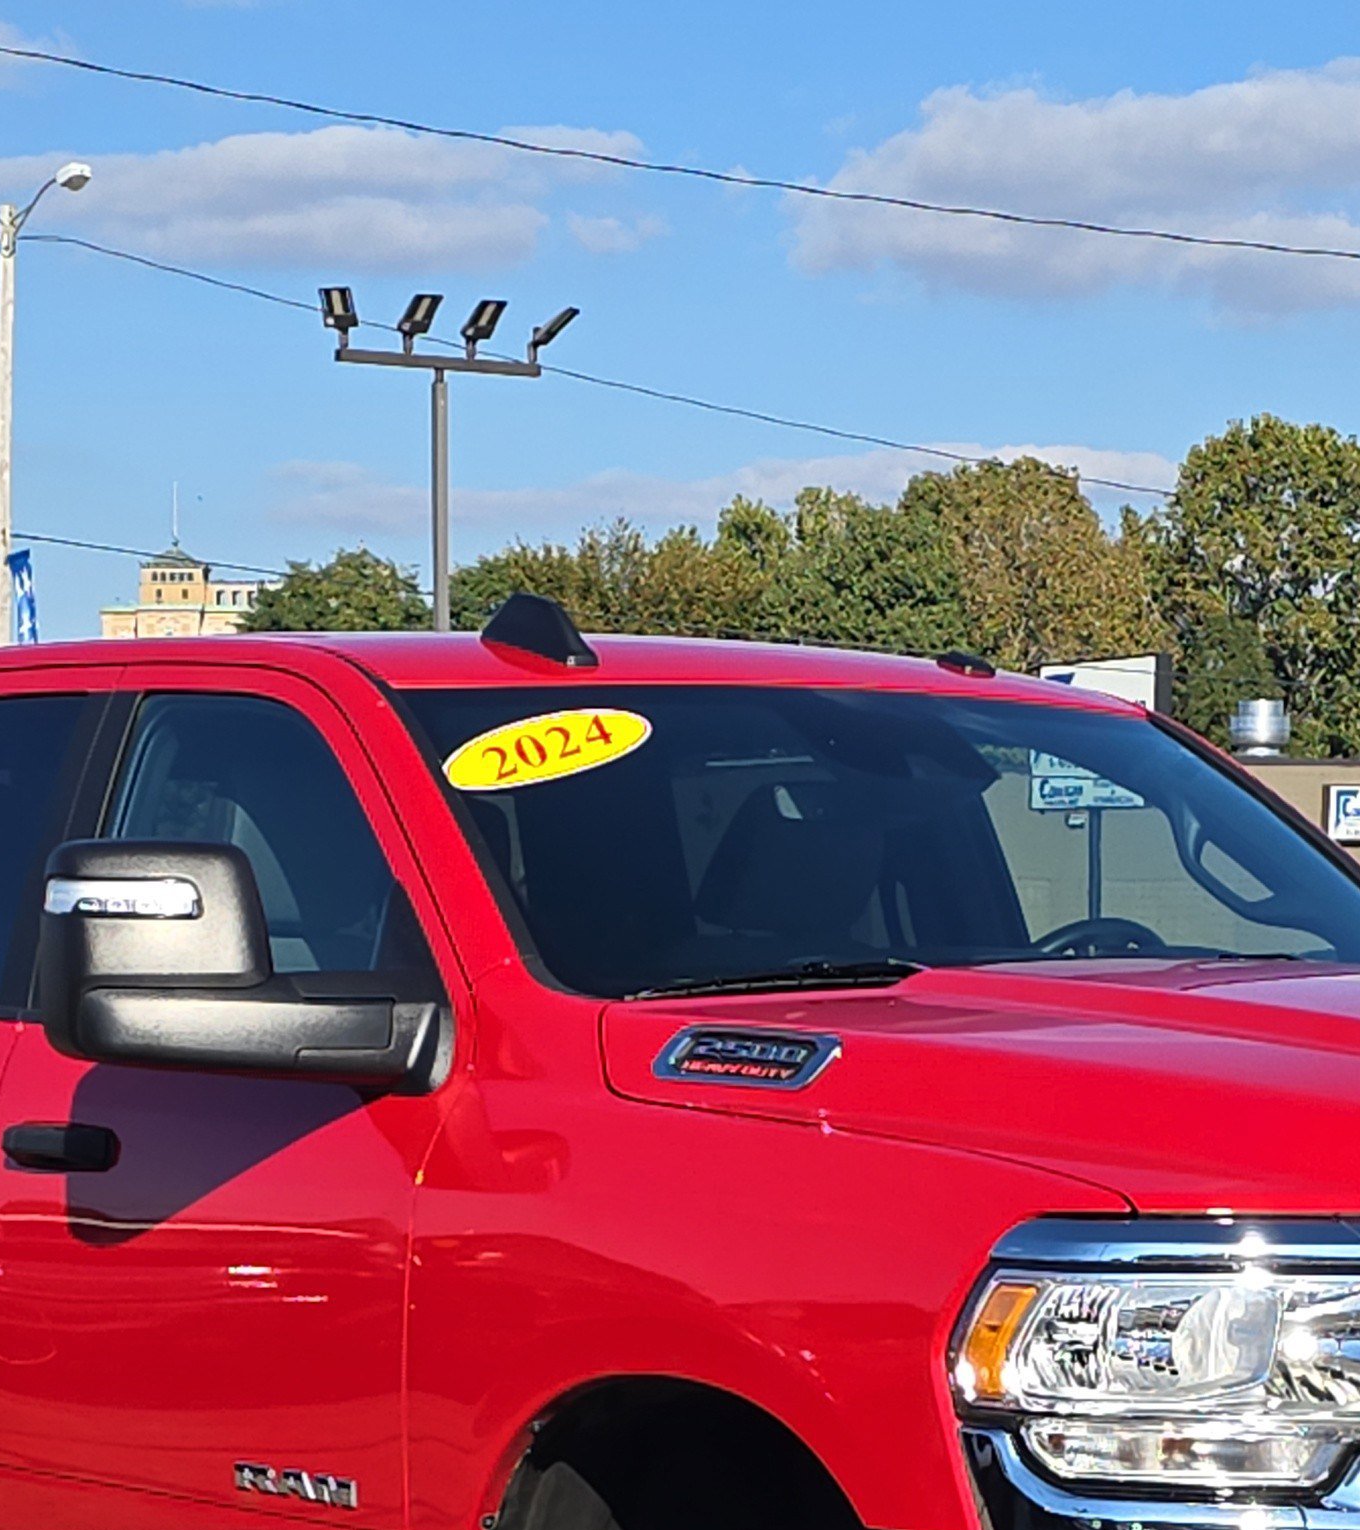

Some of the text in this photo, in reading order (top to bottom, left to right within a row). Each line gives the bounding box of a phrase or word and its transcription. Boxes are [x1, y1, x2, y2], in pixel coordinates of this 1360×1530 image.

[482, 715, 612, 781] 2024
[693, 1038, 807, 1062] 2500
[741, 1064, 795, 1078] DUTY
[234, 1461, 358, 1509] RAM
